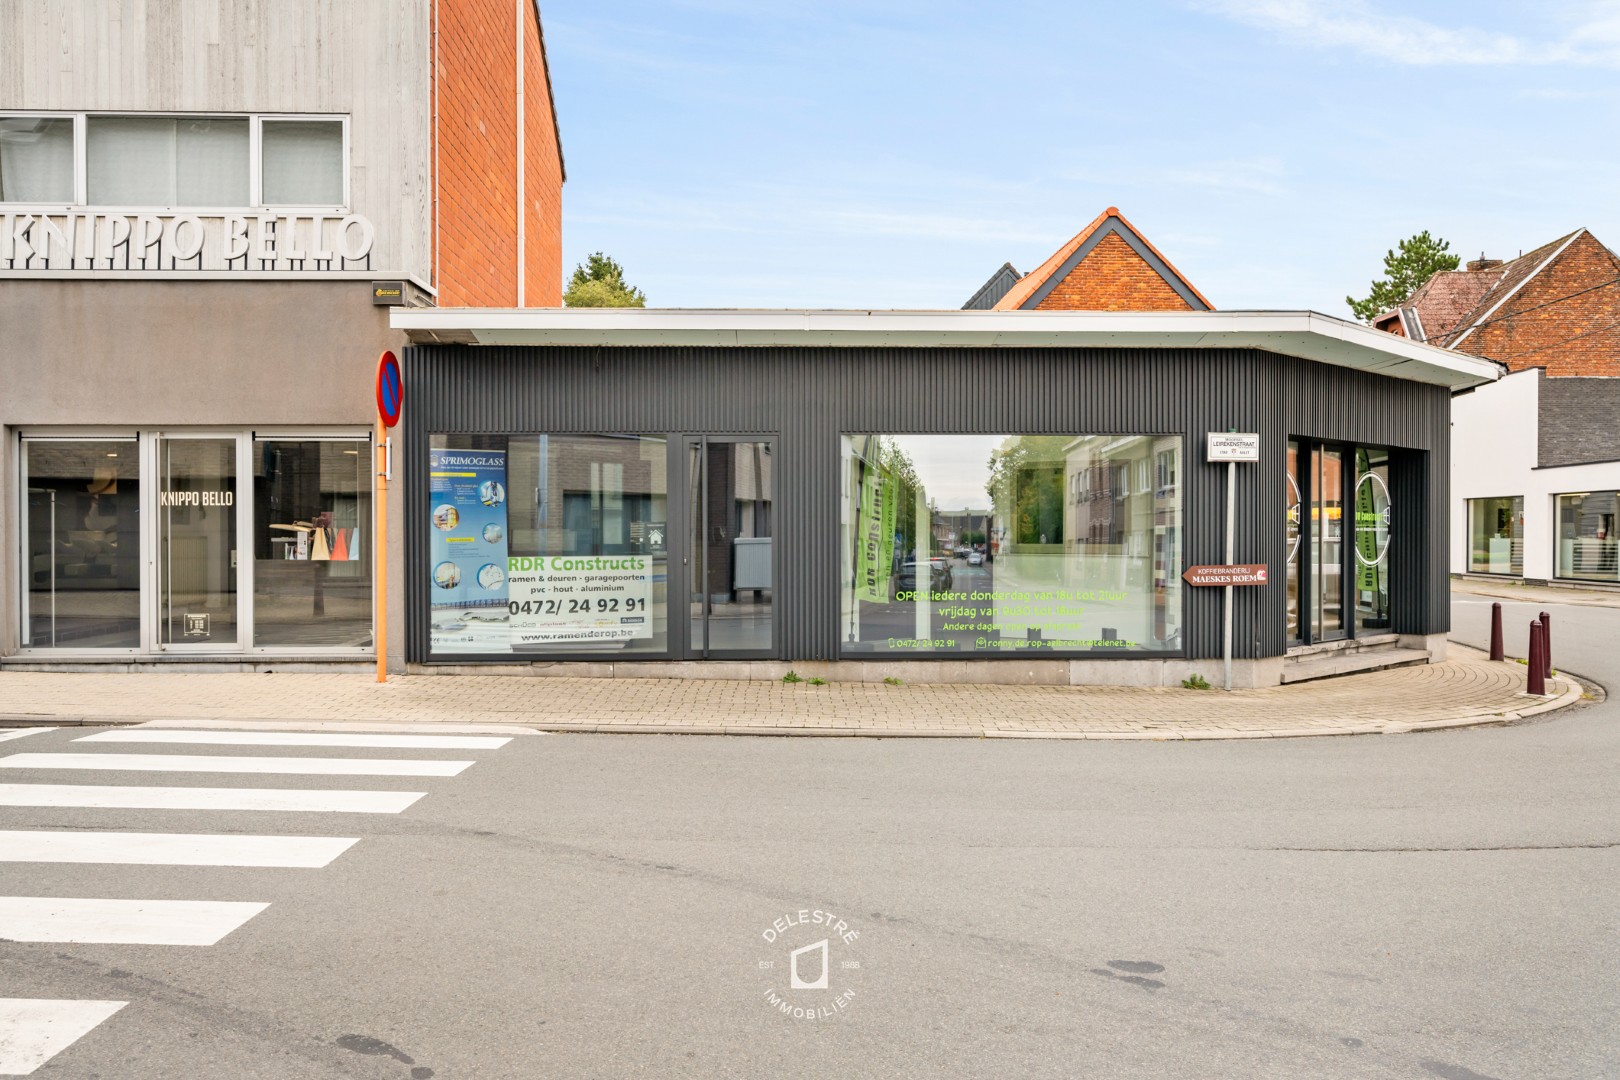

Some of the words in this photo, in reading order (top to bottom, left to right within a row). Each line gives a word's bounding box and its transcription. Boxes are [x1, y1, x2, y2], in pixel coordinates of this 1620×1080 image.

[4, 214, 205, 261] KNIPPO
[224, 214, 374, 261] BELLO
[440, 456, 505, 466] SPRIMOGLASS
[160, 491, 200, 506] KNIPPO
[202, 491, 234, 506] BELLO
[508, 556, 545, 572] RDR
[551, 557, 645, 571] Constructs
[1197, 567, 1251, 575] KOFFIEBRANDERIJ
[508, 575, 536, 583] ramen
[584, 574, 645, 583] garagepoorten
[1192, 575, 1231, 583] MAESKES
[1232, 574, 1257, 582] ROEM
[580, 584, 625, 592] aluminium
[896, 591, 929, 601] OPEN
[931, 591, 967, 601] iedere
[970, 591, 1031, 602] donderdag
[1033, 592, 1053, 600] van
[1076, 590, 1095, 600] tot
[508, 599, 562, 616] 0472/
[568, 600, 591, 614] 24
[597, 599, 619, 613] 92
[625, 598, 646, 612] 91
[938, 606, 977, 619] vrijdag
[980, 607, 1000, 616] van
[1033, 606, 1053, 616] tot
[942, 622, 975, 631] Andere
[977, 622, 1001, 632] dagen
[1029, 623, 1041, 632] op
[521, 629, 634, 641] www.ramenderop.be
[897, 640, 920, 648] 0472/
[935, 640, 945, 648] 92
[947, 640, 955, 648] 91
